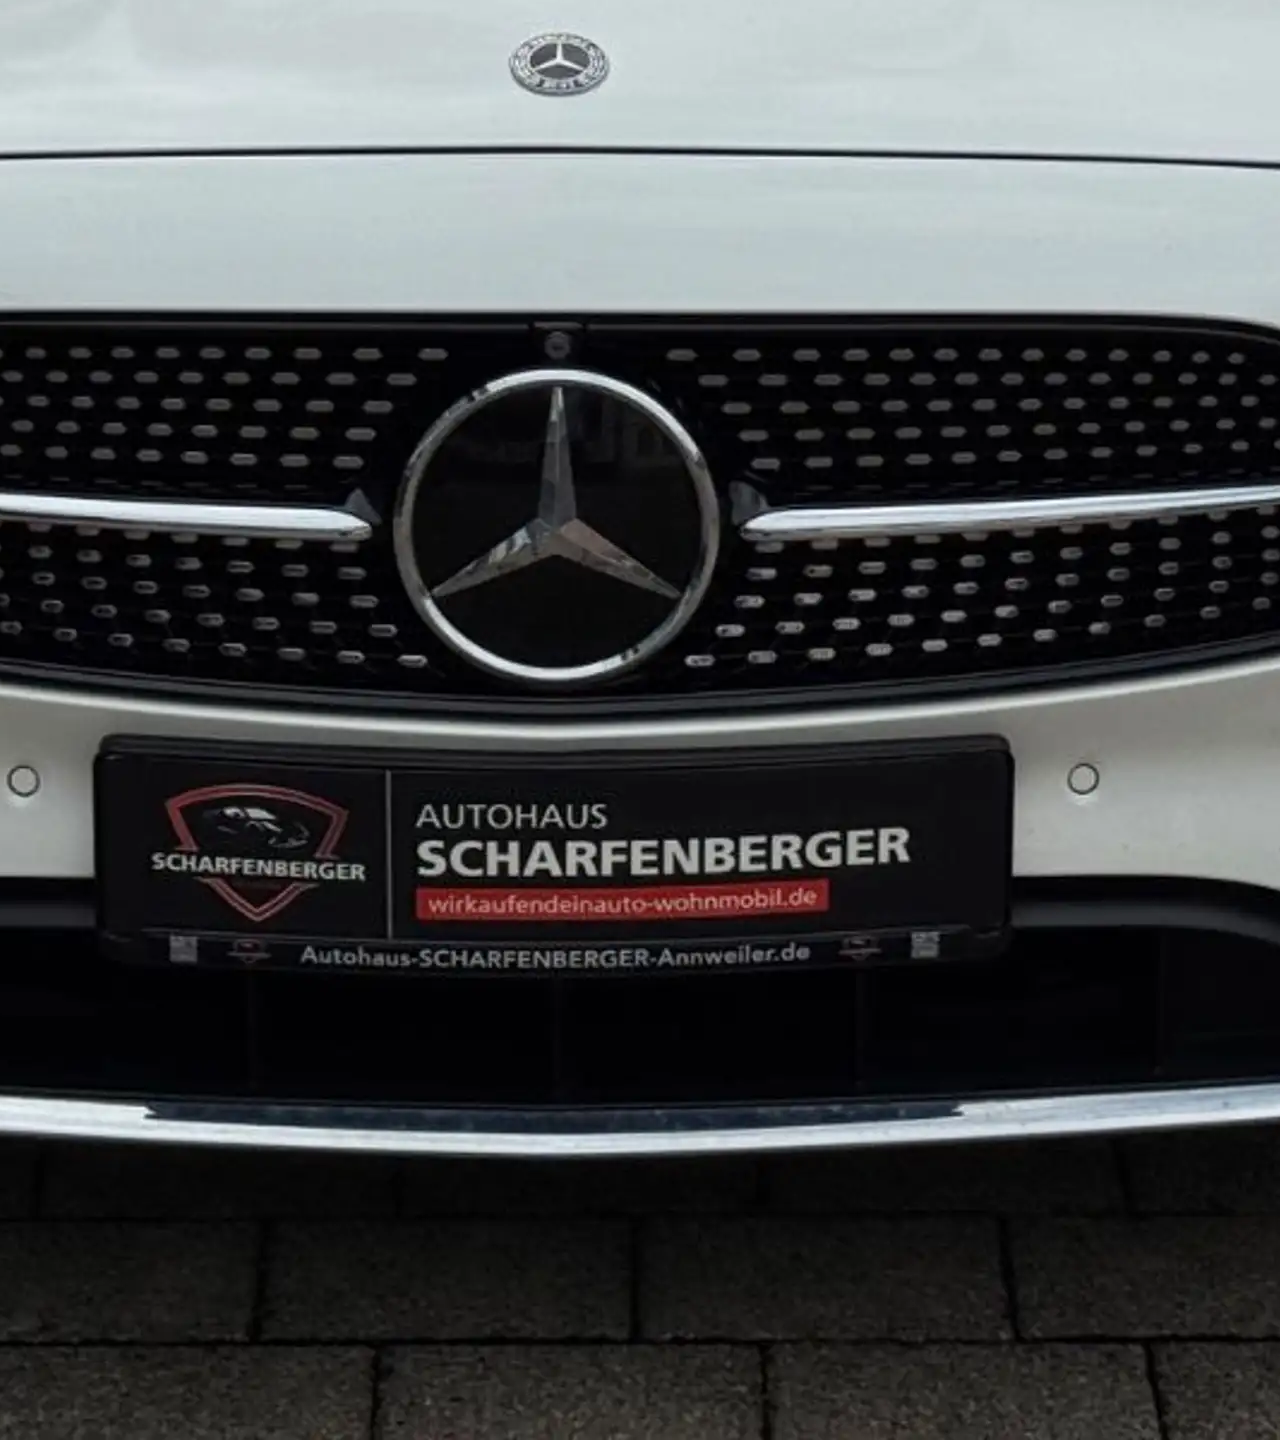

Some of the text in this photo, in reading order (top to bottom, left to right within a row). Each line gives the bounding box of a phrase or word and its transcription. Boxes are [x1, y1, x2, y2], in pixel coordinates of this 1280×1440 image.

[416, 803, 608, 829] AUTOHAUS
[416, 826, 911, 877] SCHARFENBERGER
[151, 852, 366, 881] SCHARFENBERGER
[428, 888, 817, 914] wirkaufendeinauto-wohnmobil.de
[300, 942, 811, 969] Autohaus-SCHARFENBERGER-Annweiler.de
